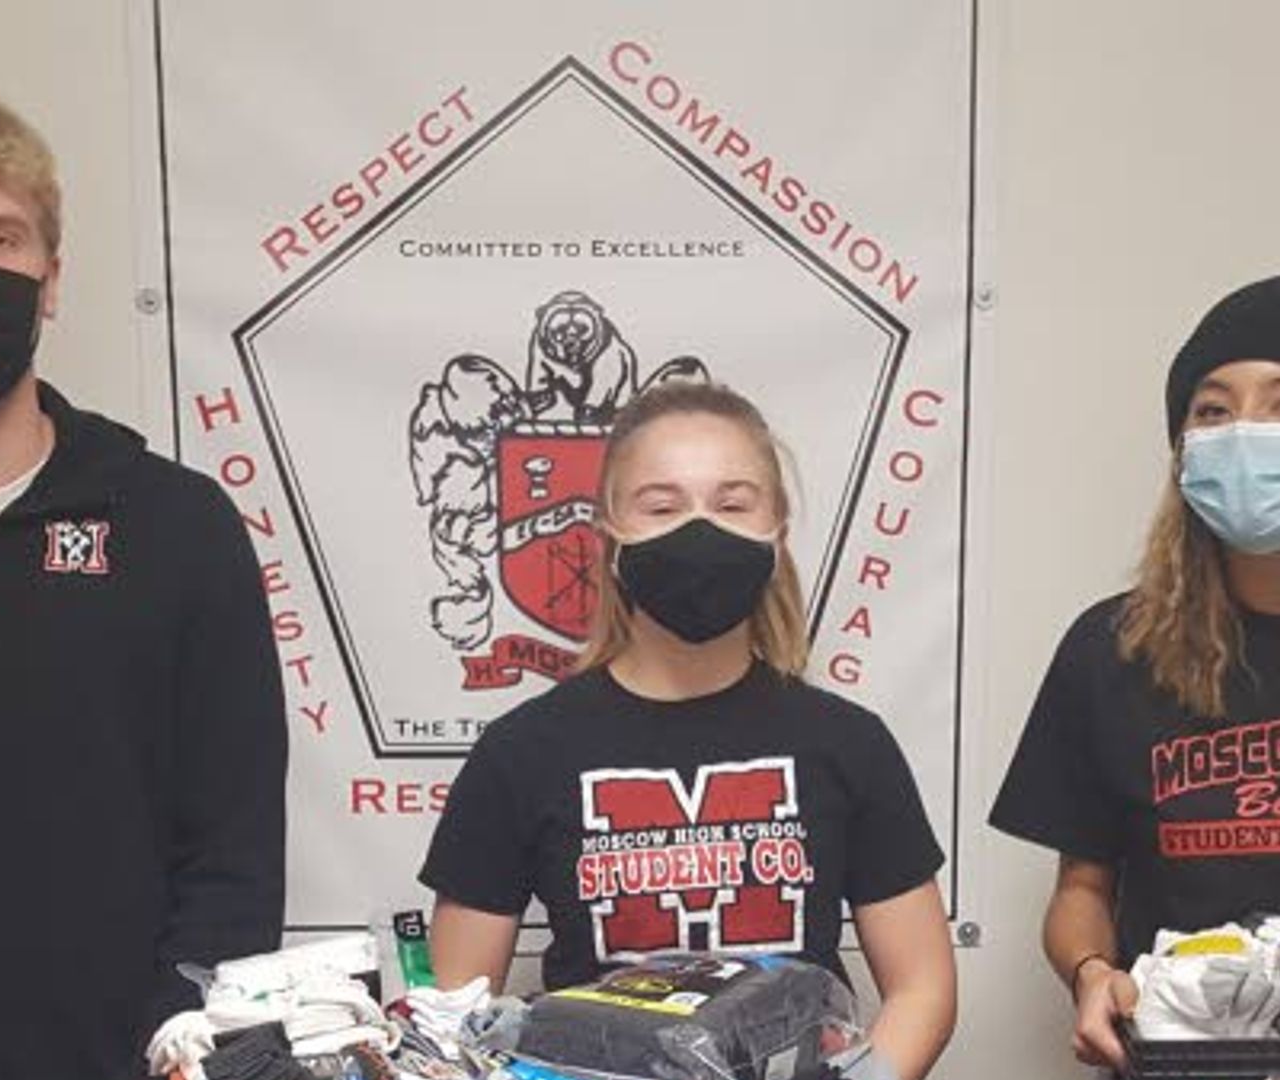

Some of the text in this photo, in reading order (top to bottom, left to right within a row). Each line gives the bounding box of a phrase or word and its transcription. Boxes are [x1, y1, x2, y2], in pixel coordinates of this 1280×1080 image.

[260, 86, 478, 274] RESPECT
[607, 40, 922, 304] COMPASSION
[195, 387, 330, 735] HONESTY
[827, 389, 944, 684] COURAG
[351, 778, 451, 815] RES
[578, 838, 814, 900] STUDENT CO.
[582, 822, 808, 852] MOSCOW HIGH SCHOOL
